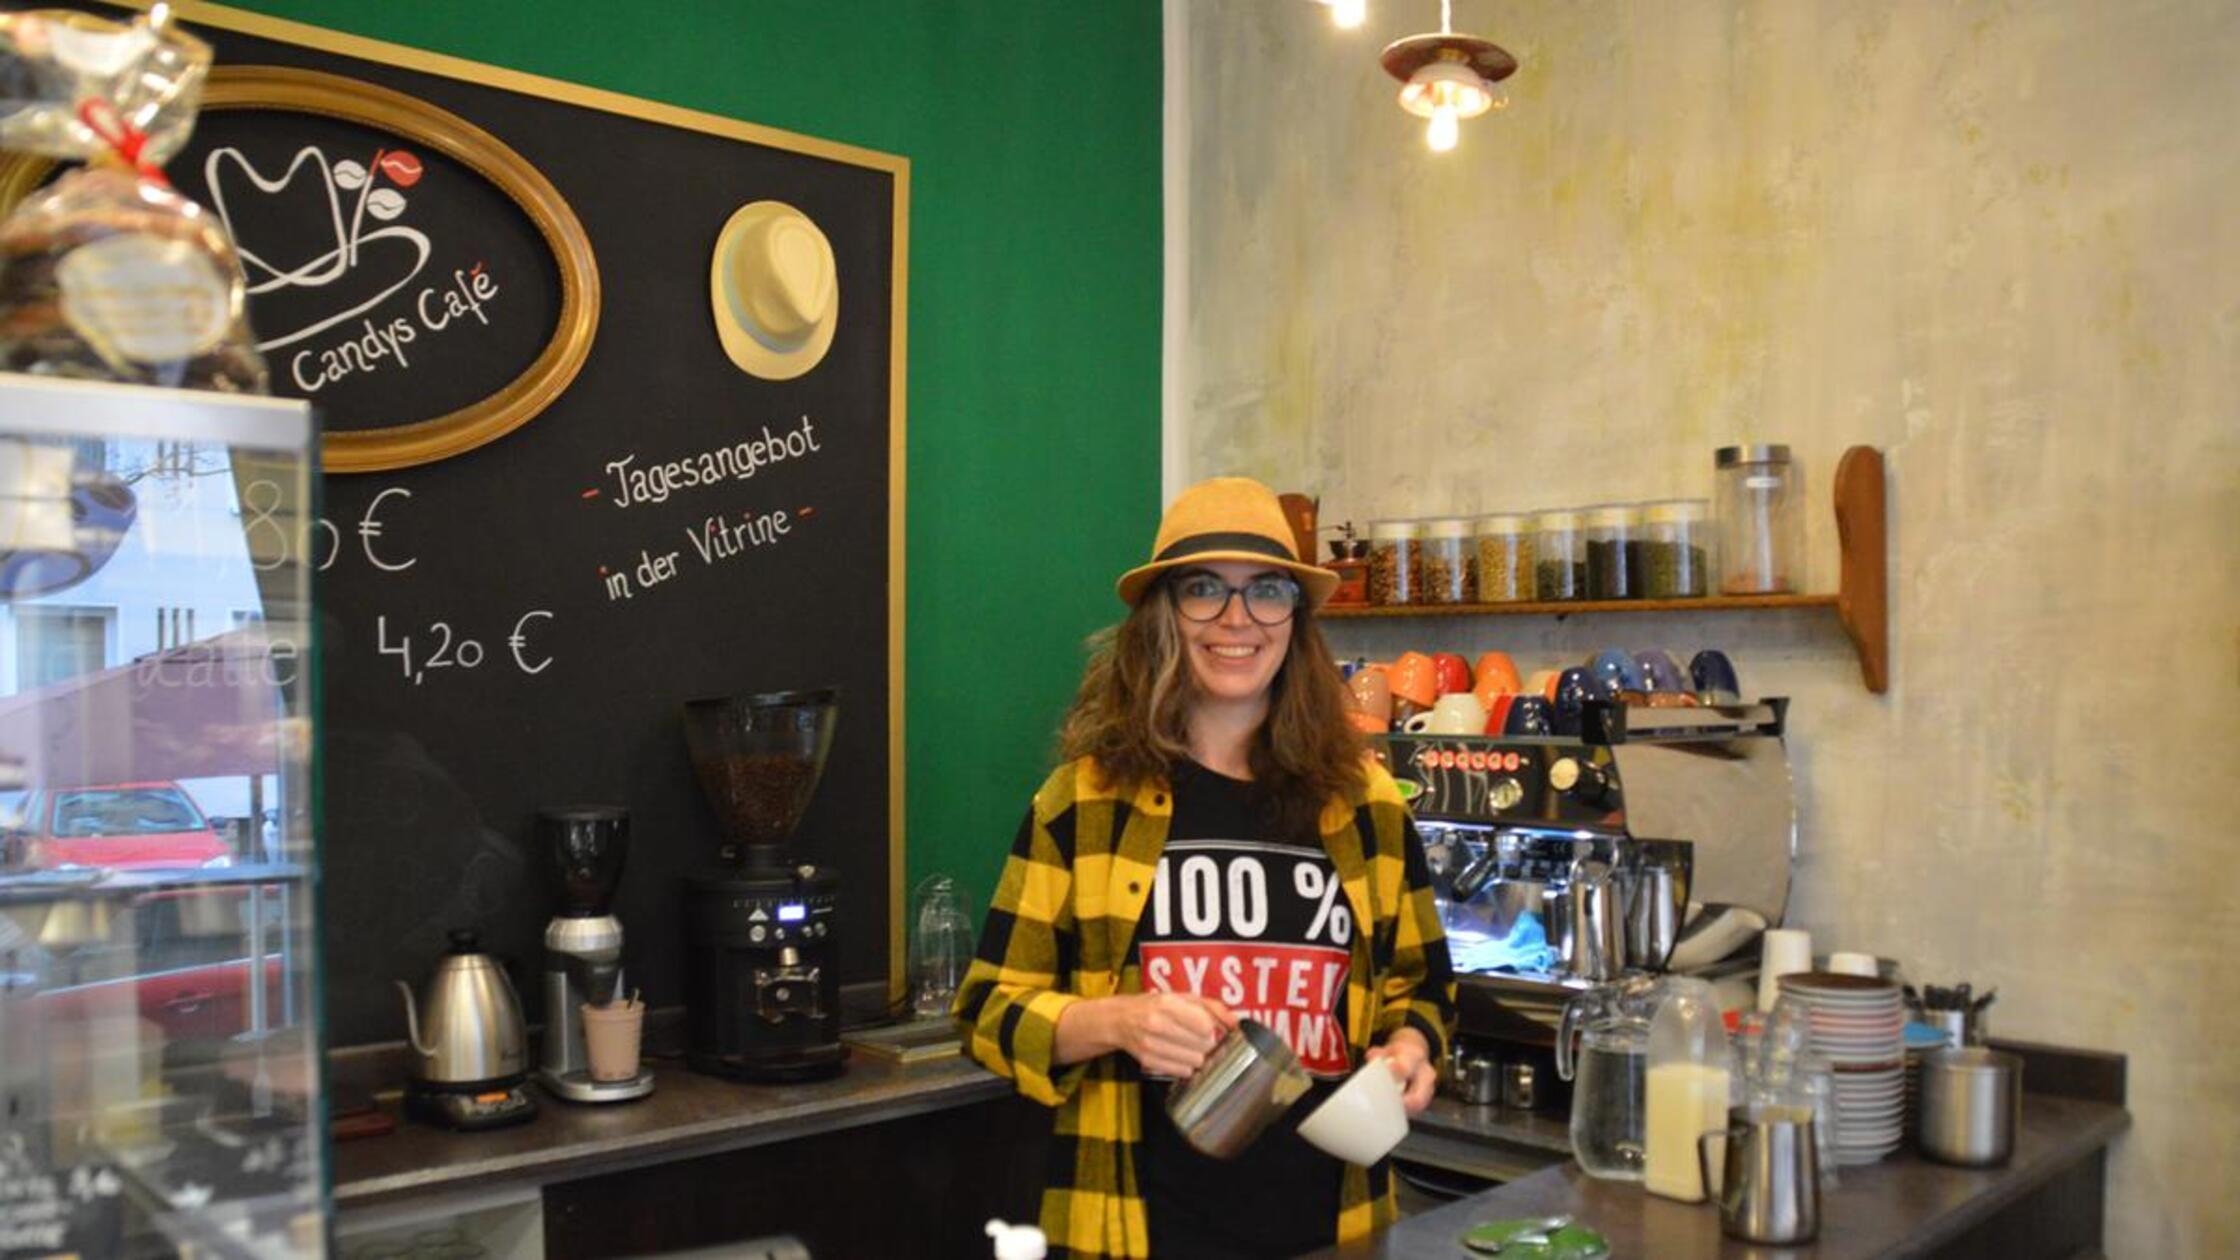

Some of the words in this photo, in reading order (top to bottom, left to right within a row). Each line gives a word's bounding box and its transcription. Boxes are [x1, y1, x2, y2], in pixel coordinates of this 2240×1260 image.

[292, 318, 416, 391] Candys
[417, 262, 498, 330] Café
[605, 415, 820, 507] Tagesangebot
[358, 488, 417, 571] €
[600, 566, 632, 600] in
[637, 550, 680, 588] der
[686, 510, 791, 564] Vitrine
[377, 615, 484, 685] 4,20
[508, 611, 553, 674] €
[1153, 855, 1268, 938] 100
[1293, 861, 1351, 945] %
